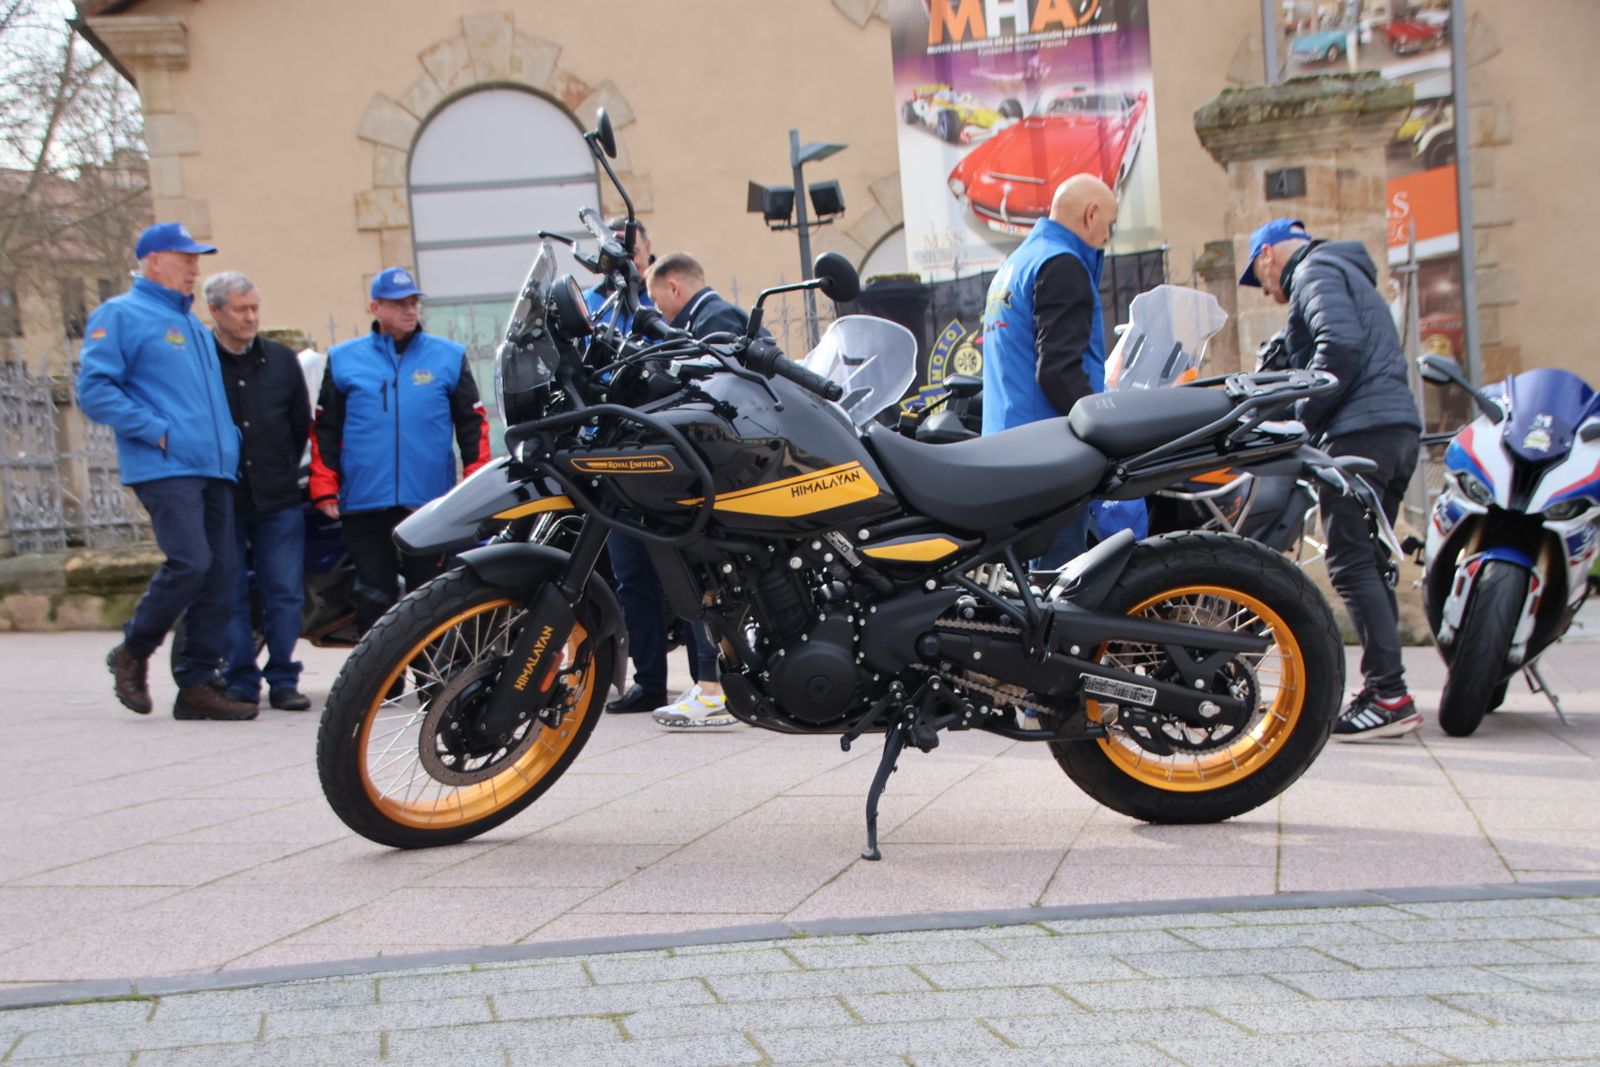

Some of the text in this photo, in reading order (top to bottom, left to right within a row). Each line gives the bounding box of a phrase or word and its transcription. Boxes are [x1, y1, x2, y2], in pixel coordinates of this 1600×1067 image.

[928, 0, 1079, 44] MHA
[1274, 169, 1289, 196] 4
[1385, 191, 1410, 219] S
[932, 329, 957, 381] MOTO
[608, 460, 656, 469] ROYAL ENFIELD
[791, 470, 861, 498] HIMALAYAN
[514, 625, 554, 691] HIMALAYAN
